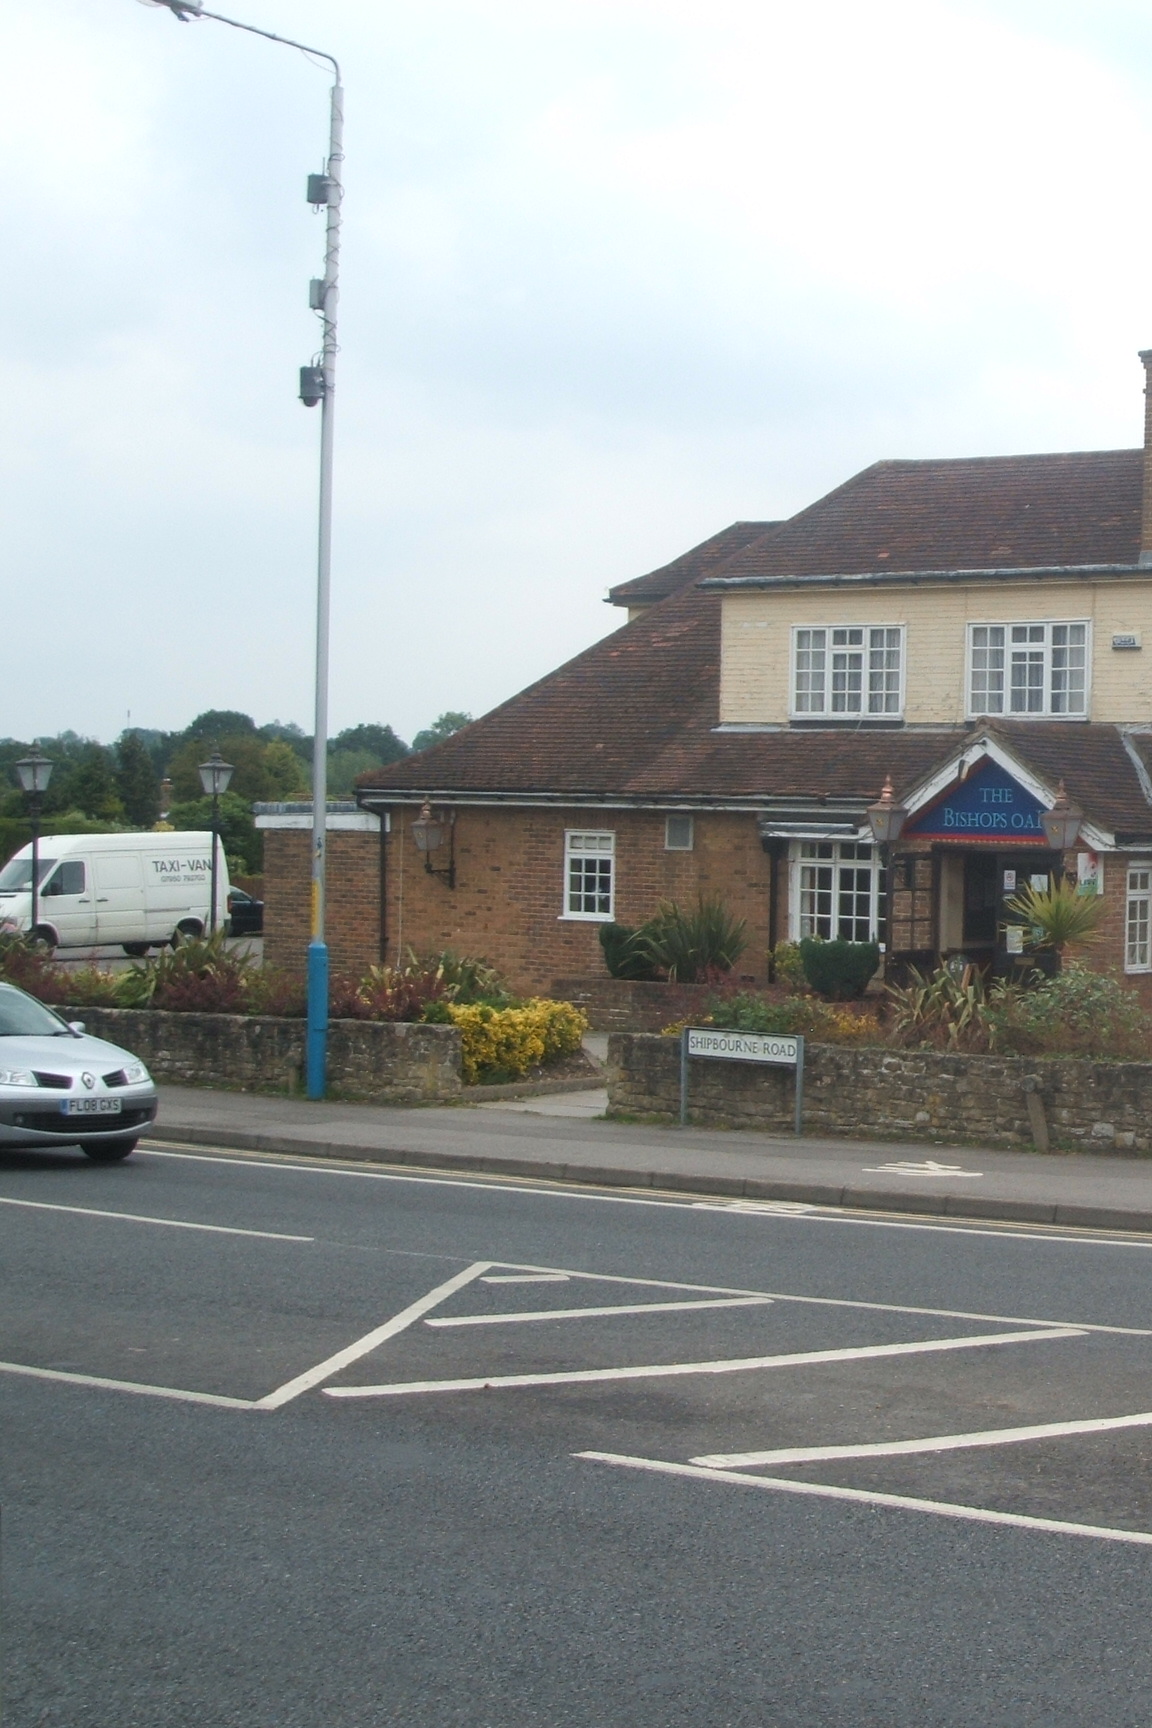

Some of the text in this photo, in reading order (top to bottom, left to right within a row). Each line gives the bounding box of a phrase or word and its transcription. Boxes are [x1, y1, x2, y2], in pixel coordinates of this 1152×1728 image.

[979, 788, 1013, 803] THE
[943, 808, 1008, 829] BISHOPS
[152, 859, 212, 873] TAXI-VAN
[690, 1036, 796, 1057] SHIPBOURNE ROAD
